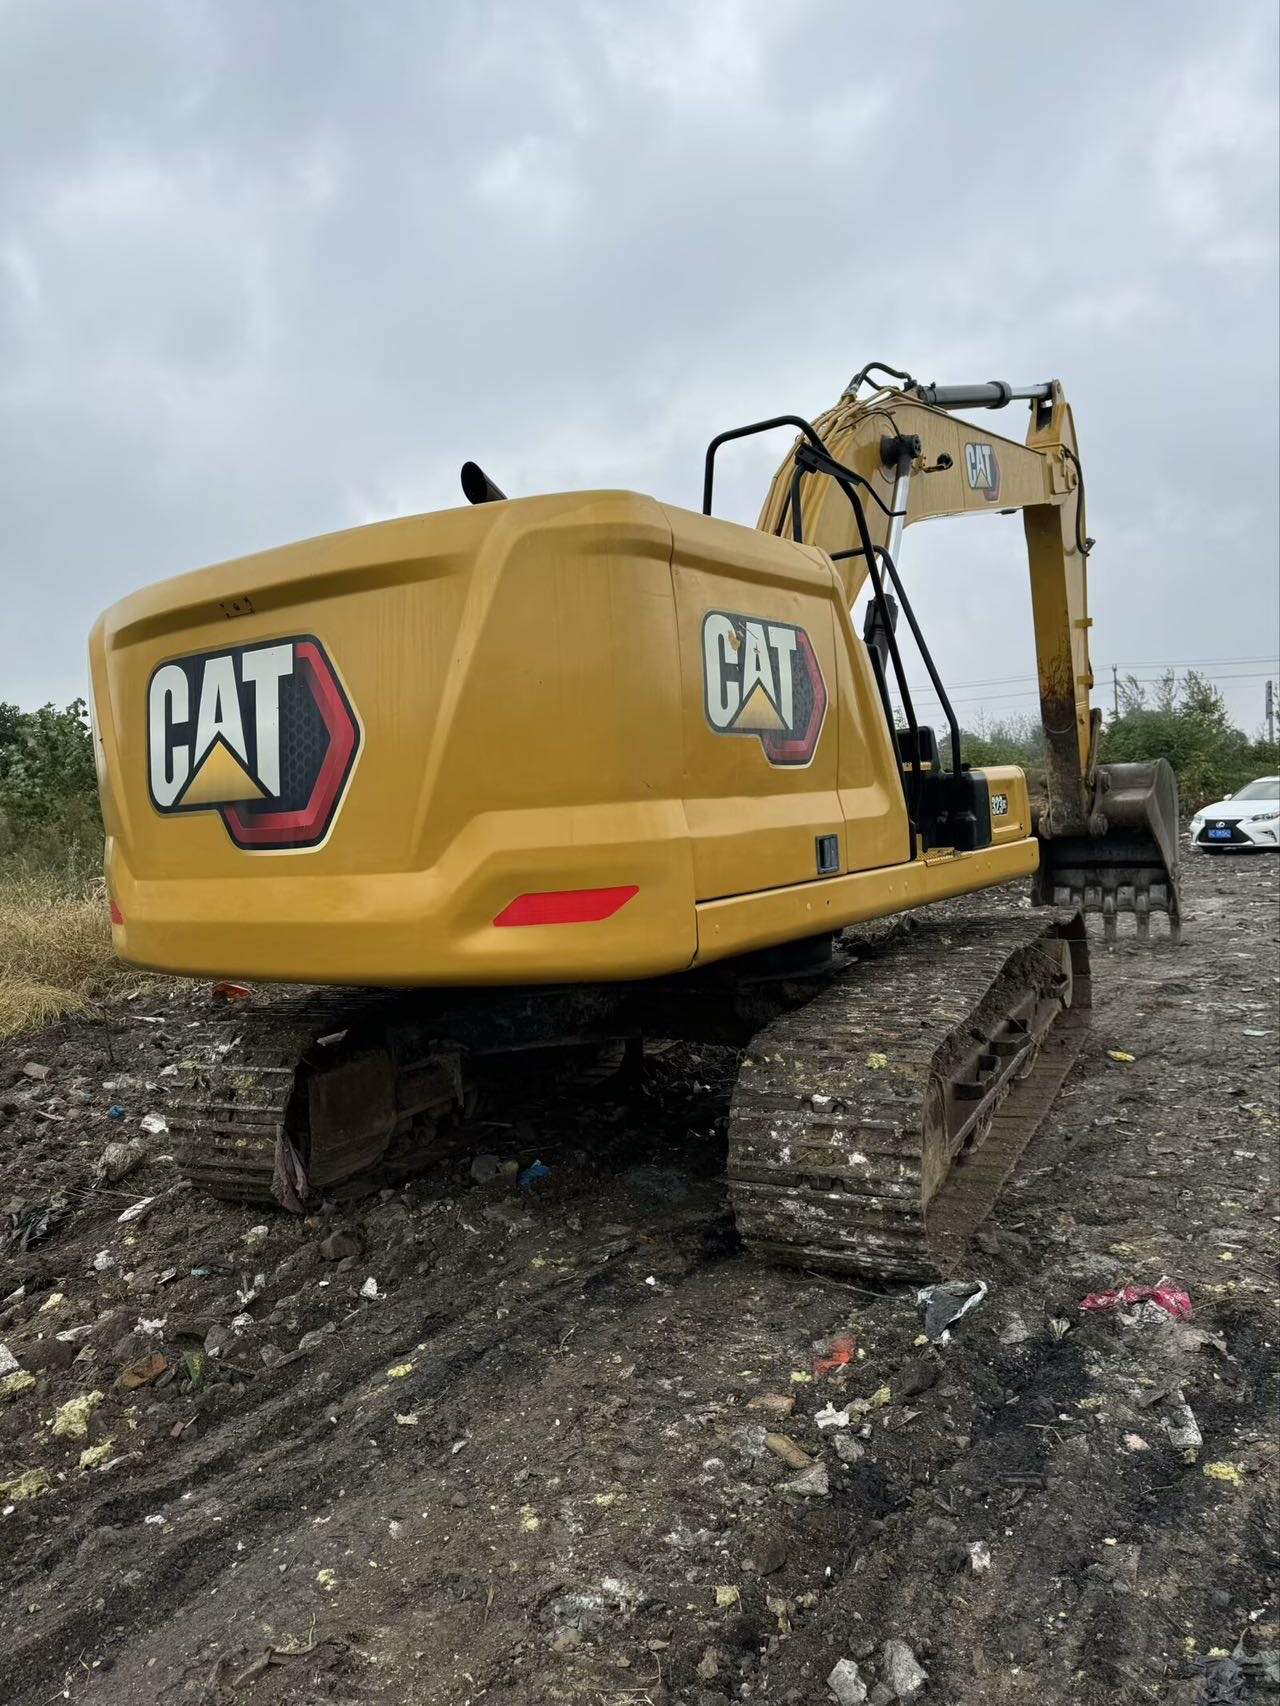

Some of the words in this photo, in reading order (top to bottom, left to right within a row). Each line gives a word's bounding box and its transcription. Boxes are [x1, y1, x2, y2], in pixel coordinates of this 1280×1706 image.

[966, 444, 992, 488] CAT
[150, 643, 293, 807] CAT
[704, 614, 797, 730] CAT
